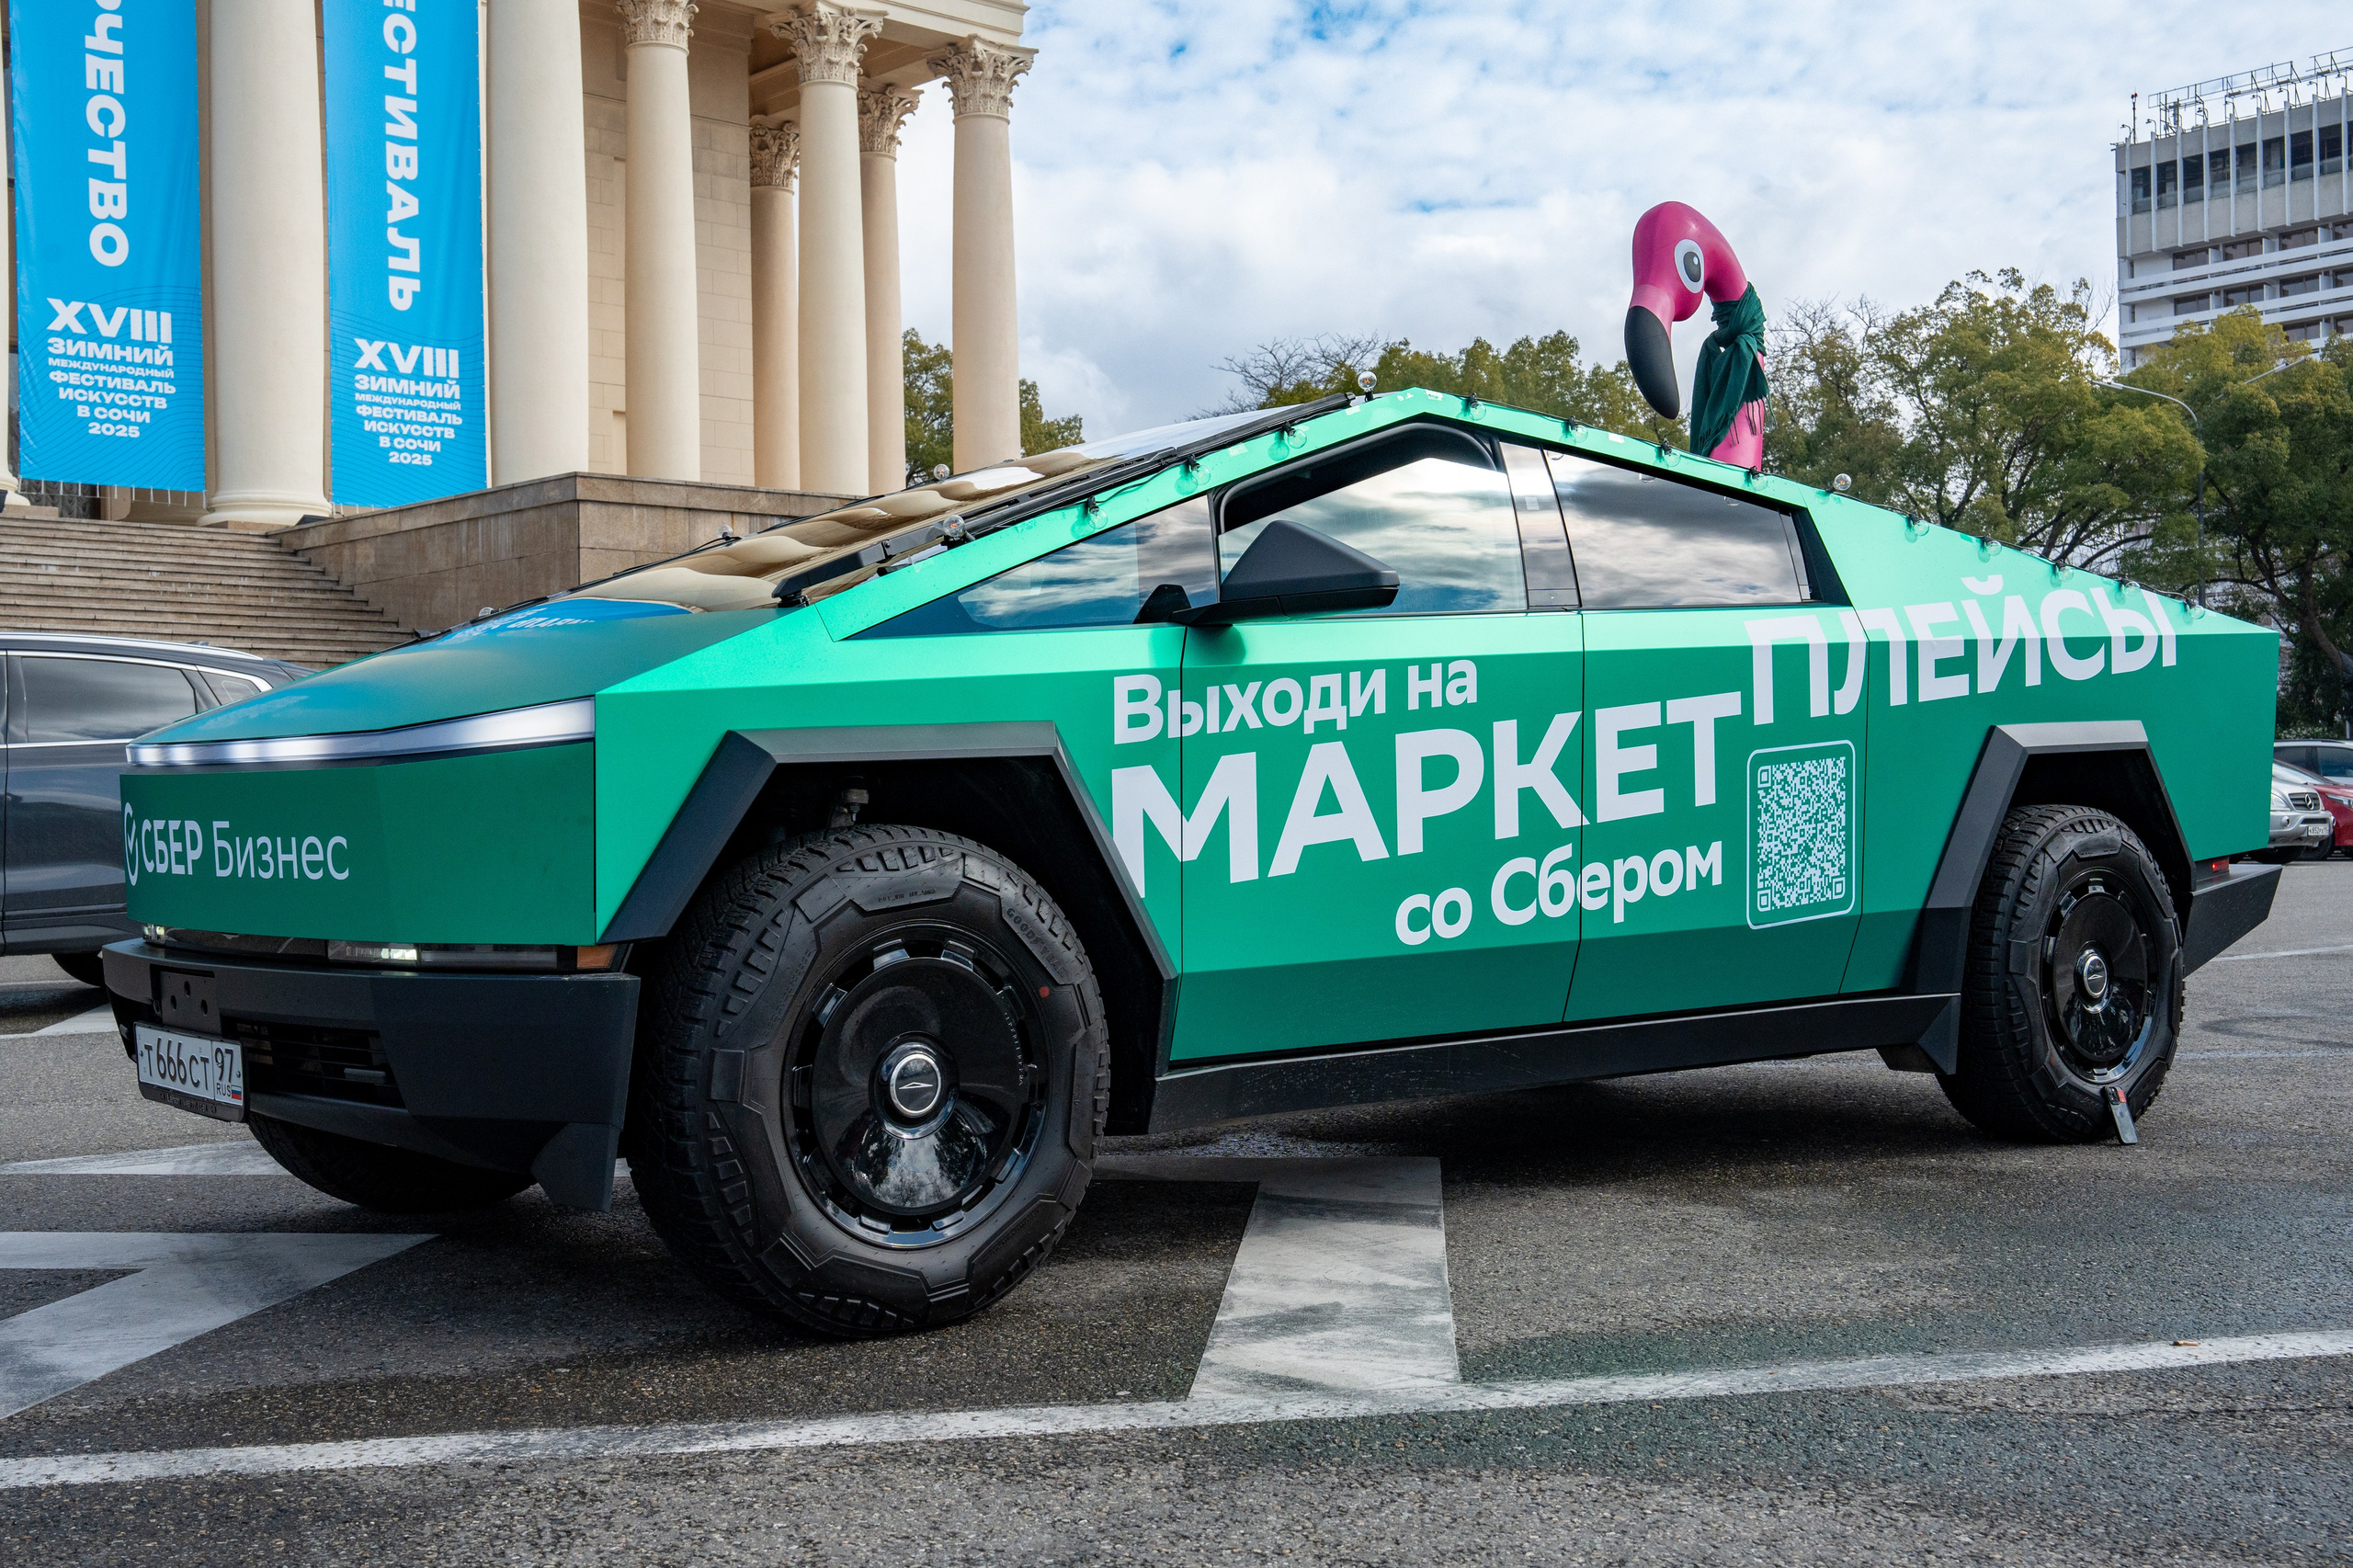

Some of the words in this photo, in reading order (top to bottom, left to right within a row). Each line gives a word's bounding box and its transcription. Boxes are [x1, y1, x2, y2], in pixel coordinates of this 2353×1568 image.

[85, 0, 129, 267] ЧЕСТВО
[46, 297, 173, 344] XVIII
[47, 336, 174, 366] ЗИМНИЙ
[353, 337, 460, 379] XVIII
[48, 357, 175, 379] МЕЖДУНАРОДНЫЙ
[49, 369, 176, 394] ФЕСТИВАЛЬ
[354, 373, 460, 399] ЗИМНИЙ
[58, 387, 167, 409] ИСКУССТВ
[354, 392, 461, 411] МЕЖДУНАРОДНЫЙ
[76, 404, 90, 417] В
[94, 406, 151, 424] СОЧИ
[356, 403, 463, 426] ФЕСТИВАЛЬ
[87, 422, 141, 438] 2025
[363, 419, 456, 439] ИСКУССТВ
[379, 435, 391, 448] В
[393, 437, 441, 452] СОЧИ
[388, 451, 433, 466] 2025
[1113, 674, 1386, 745] Выходи
[1407, 659, 1478, 710] на
[142, 819, 203, 875] СБЕР
[212, 820, 349, 881] Бизнес
[1395, 887, 1473, 946] со
[1491, 842, 1722, 926] Сбером
[216, 1083, 231, 1096] RUS
